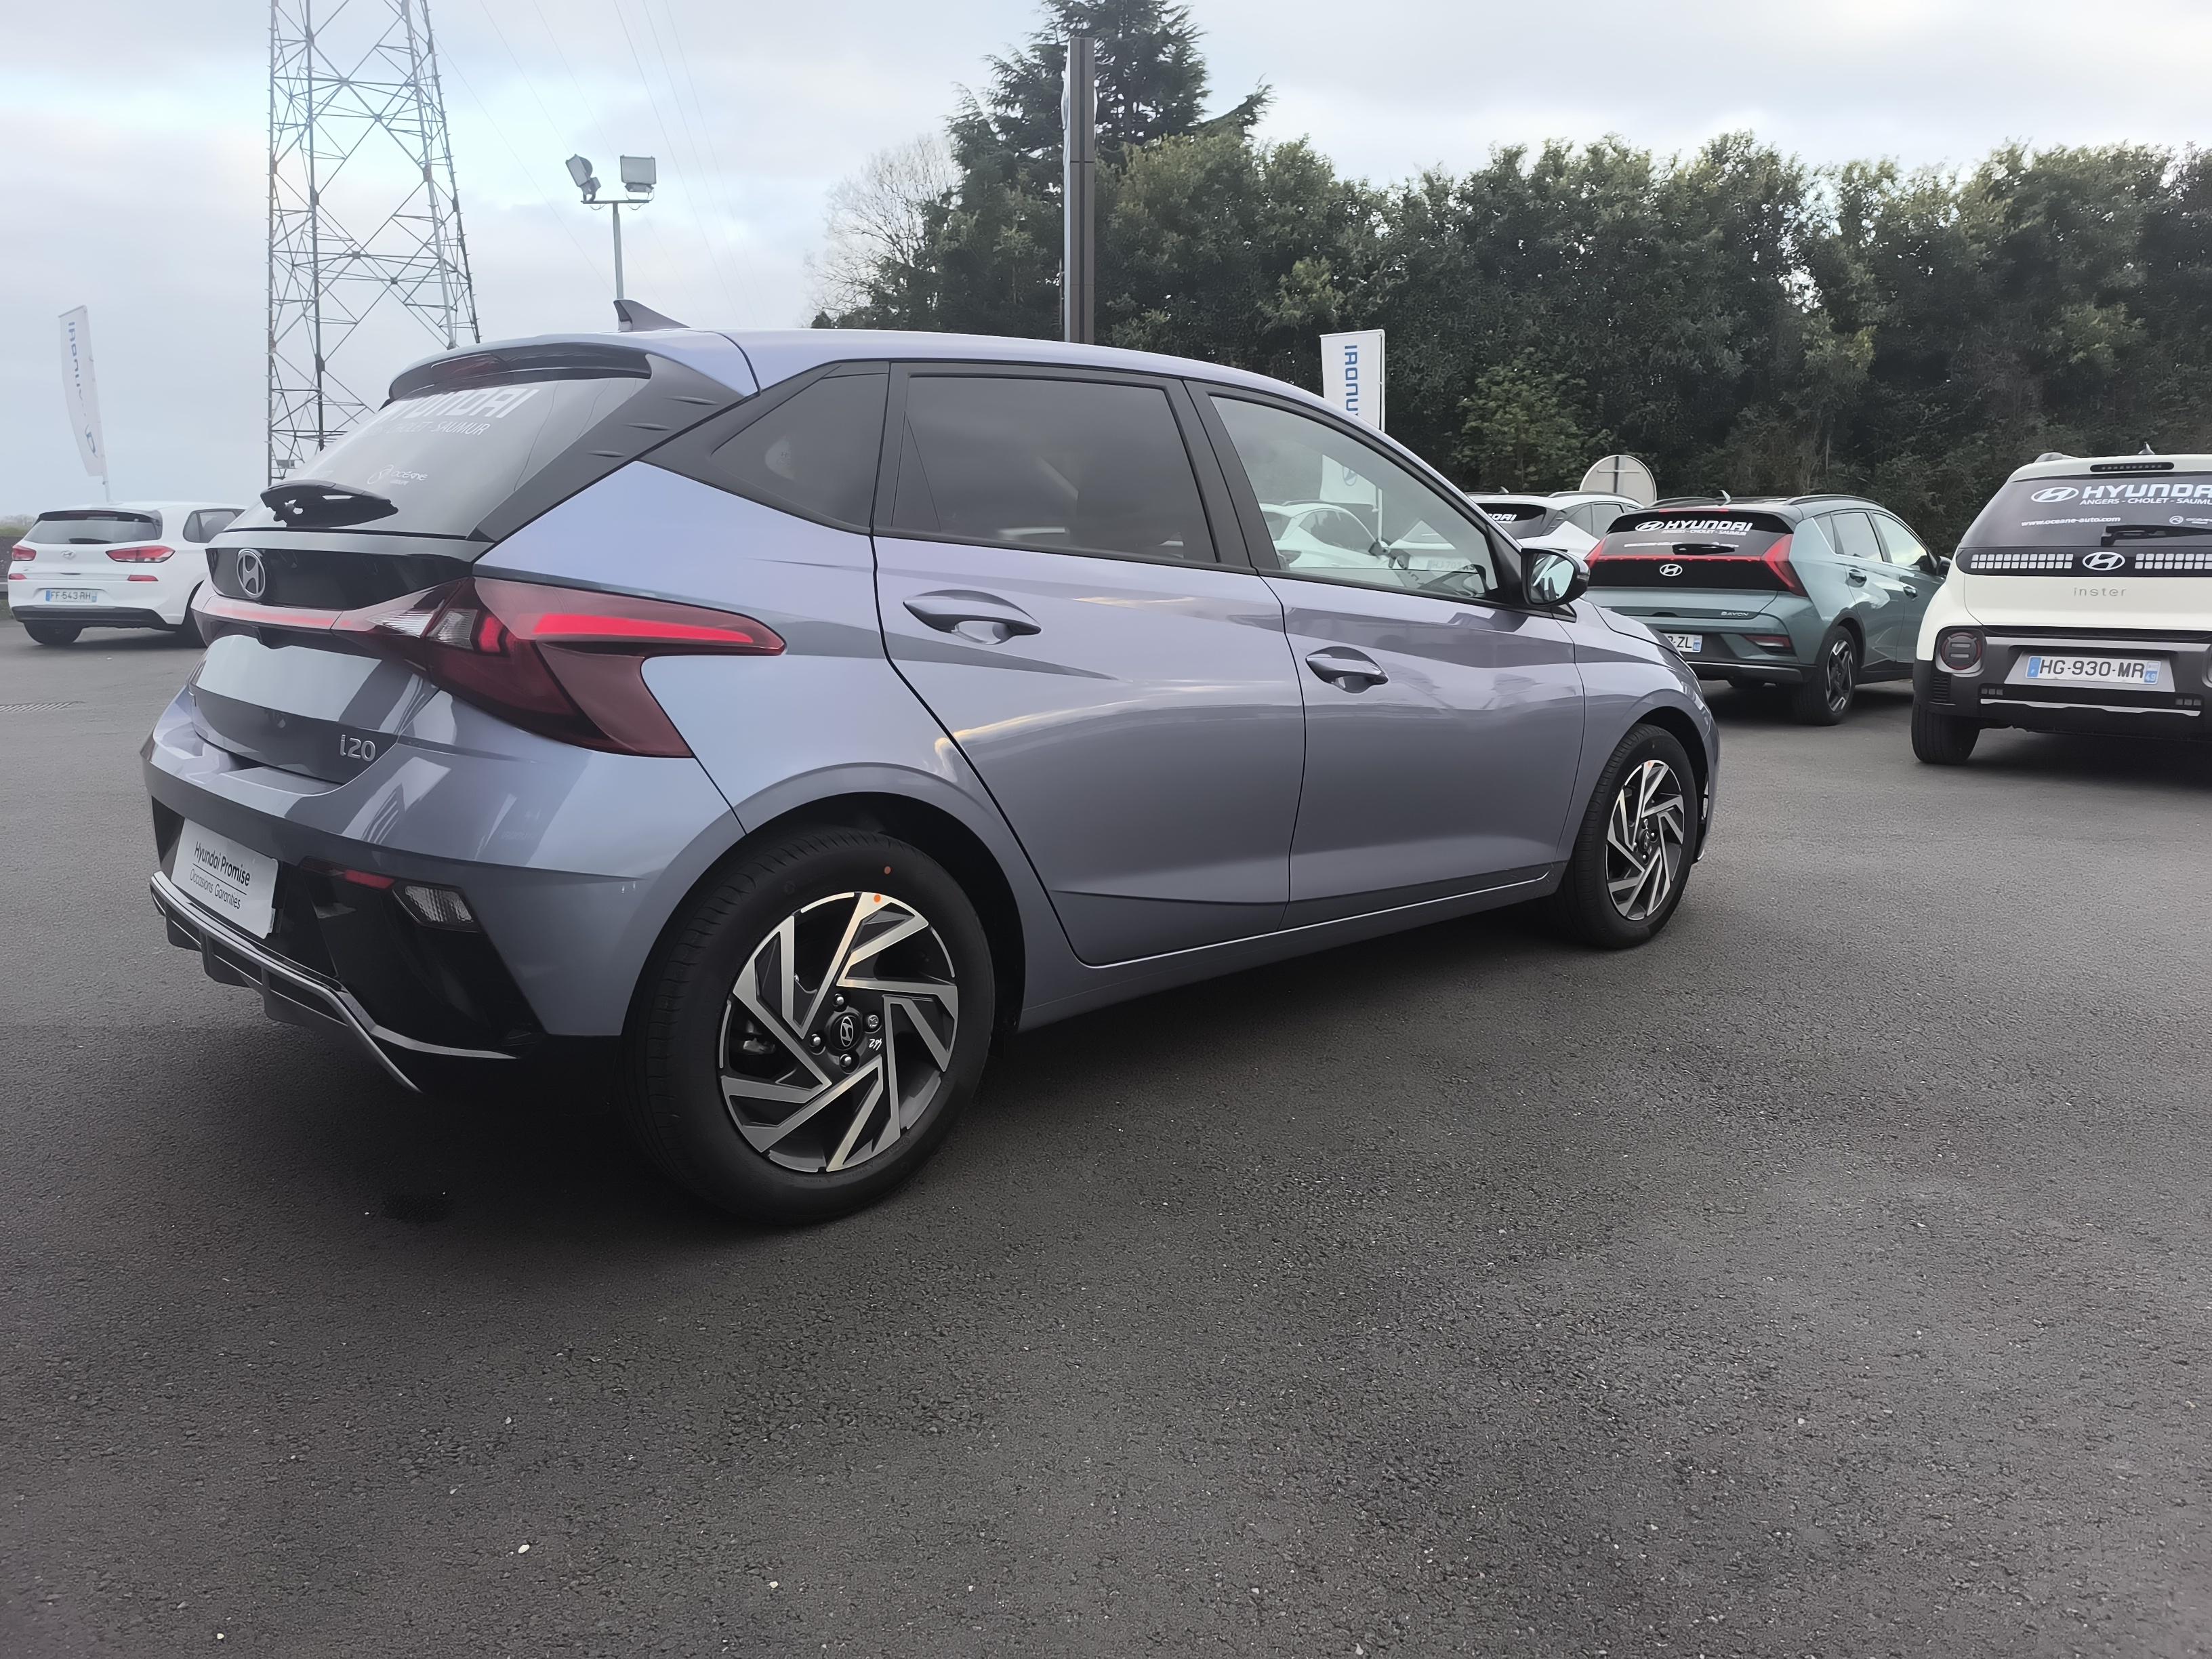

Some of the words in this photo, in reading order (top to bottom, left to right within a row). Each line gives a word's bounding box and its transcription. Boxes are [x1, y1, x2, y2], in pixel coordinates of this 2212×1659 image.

[2081, 483, 2212, 499] HYUNDA
[2175, 497, 2212, 506] SAUMU
[1663, 520, 1753, 532] HYUNDAI
[2074, 587, 2127, 596] inster
[2039, 659, 2145, 678] HG-930-MR
[194, 841, 222, 870] Hyundai
[220, 855, 251, 886] Promise
[190, 868, 213, 893] Occasions
[214, 883, 241, 909] Garanties
